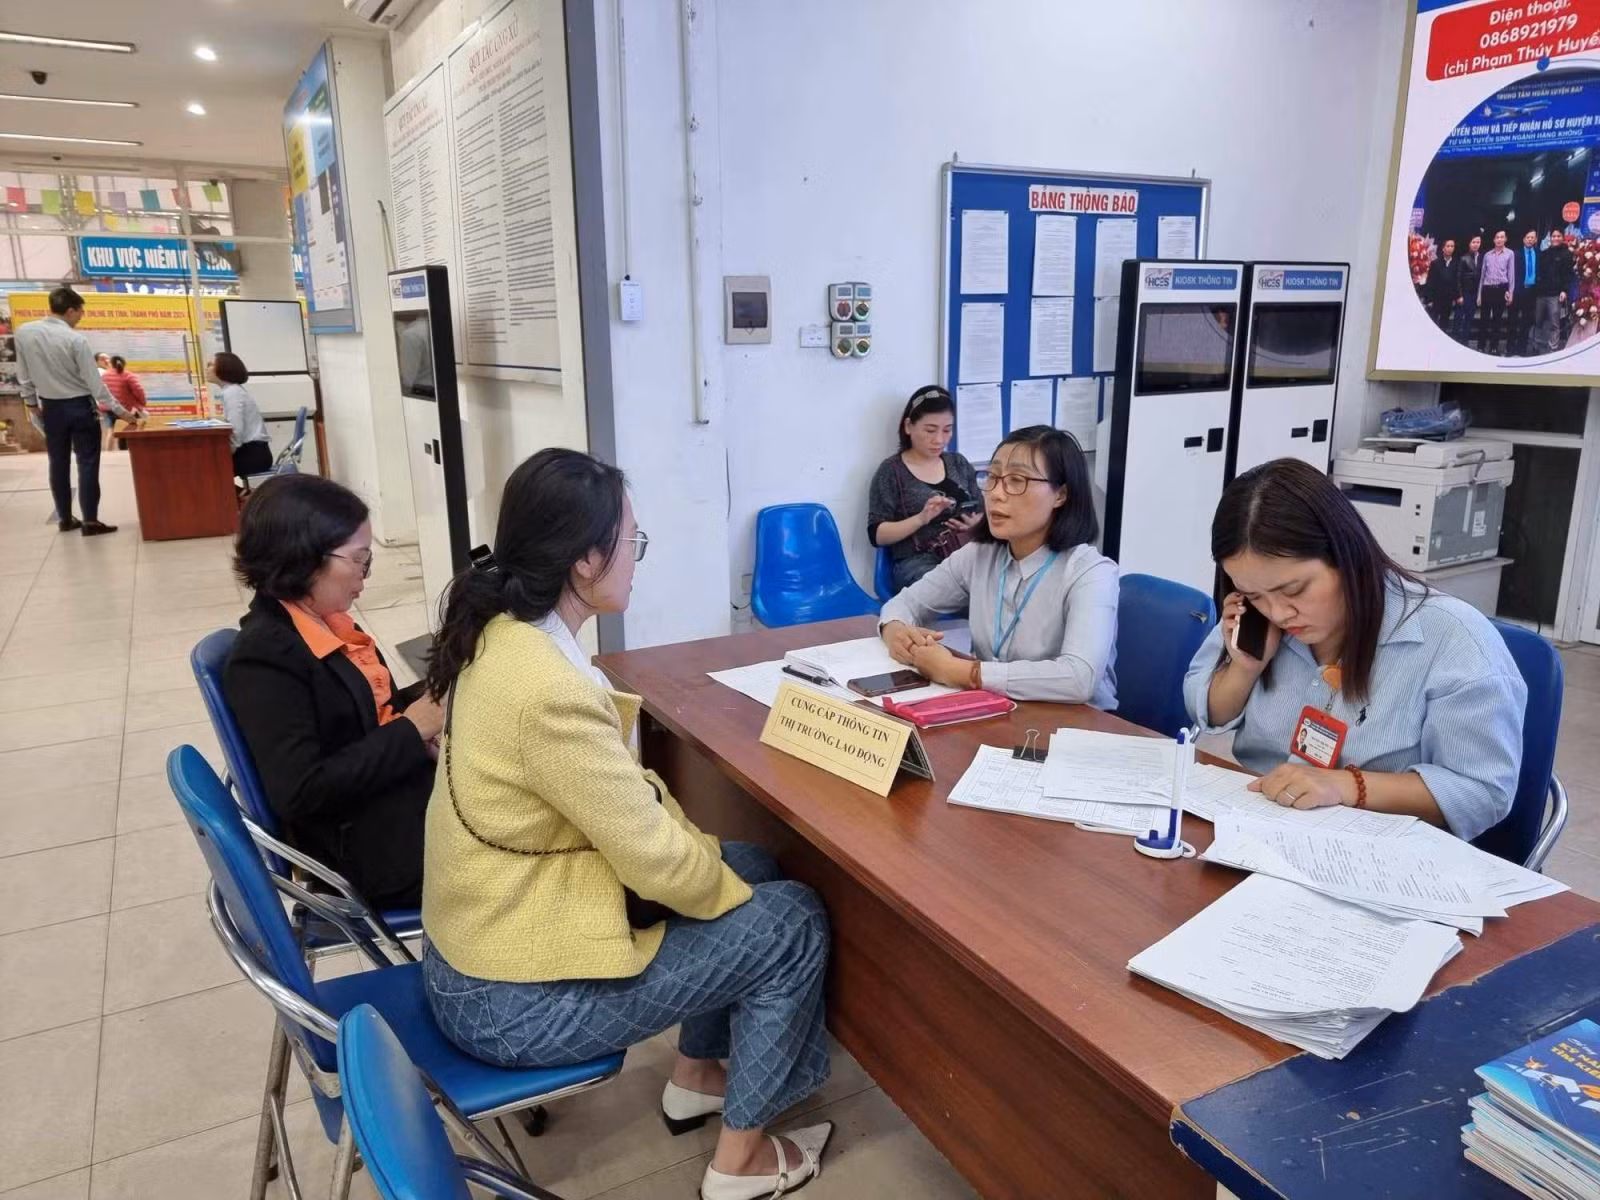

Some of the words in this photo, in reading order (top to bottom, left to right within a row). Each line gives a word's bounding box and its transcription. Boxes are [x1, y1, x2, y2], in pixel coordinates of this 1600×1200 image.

[1480, 13, 1578, 49] 0868921979
[1490, 8, 1523, 26] Điện
[1443, 61, 1469, 78] (chị
[1472, 52, 1512, 72] Phạm
[1517, 43, 1554, 61] Thúy
[1472, 124, 1489, 136] SINH
[1502, 120, 1518, 134] TIẾP
[1520, 119, 1541, 132] NHẬN
[1031, 185, 1066, 209] BẢNG
[1112, 191, 1136, 213] BÁO
[87, 246, 114, 268] KHU
[116, 246, 143, 273] VỰC
[144, 244, 178, 269] NIÊM
[1175, 276, 1197, 285] KIOSK
[1198, 274, 1221, 285] THÔNG
[1223, 276, 1233, 285] TIN
[1285, 277, 1305, 286] KIOSK
[1306, 275, 1327, 286] THÔNG
[1329, 277, 1339, 286] TIN
[791, 696, 816, 714] CUNG
[836, 714, 871, 736] THÔNG
[872, 728, 890, 743] TIN
[780, 715, 796, 732] THỊ
[797, 721, 836, 746] TRƯỜNG
[835, 738, 857, 755] LAO
